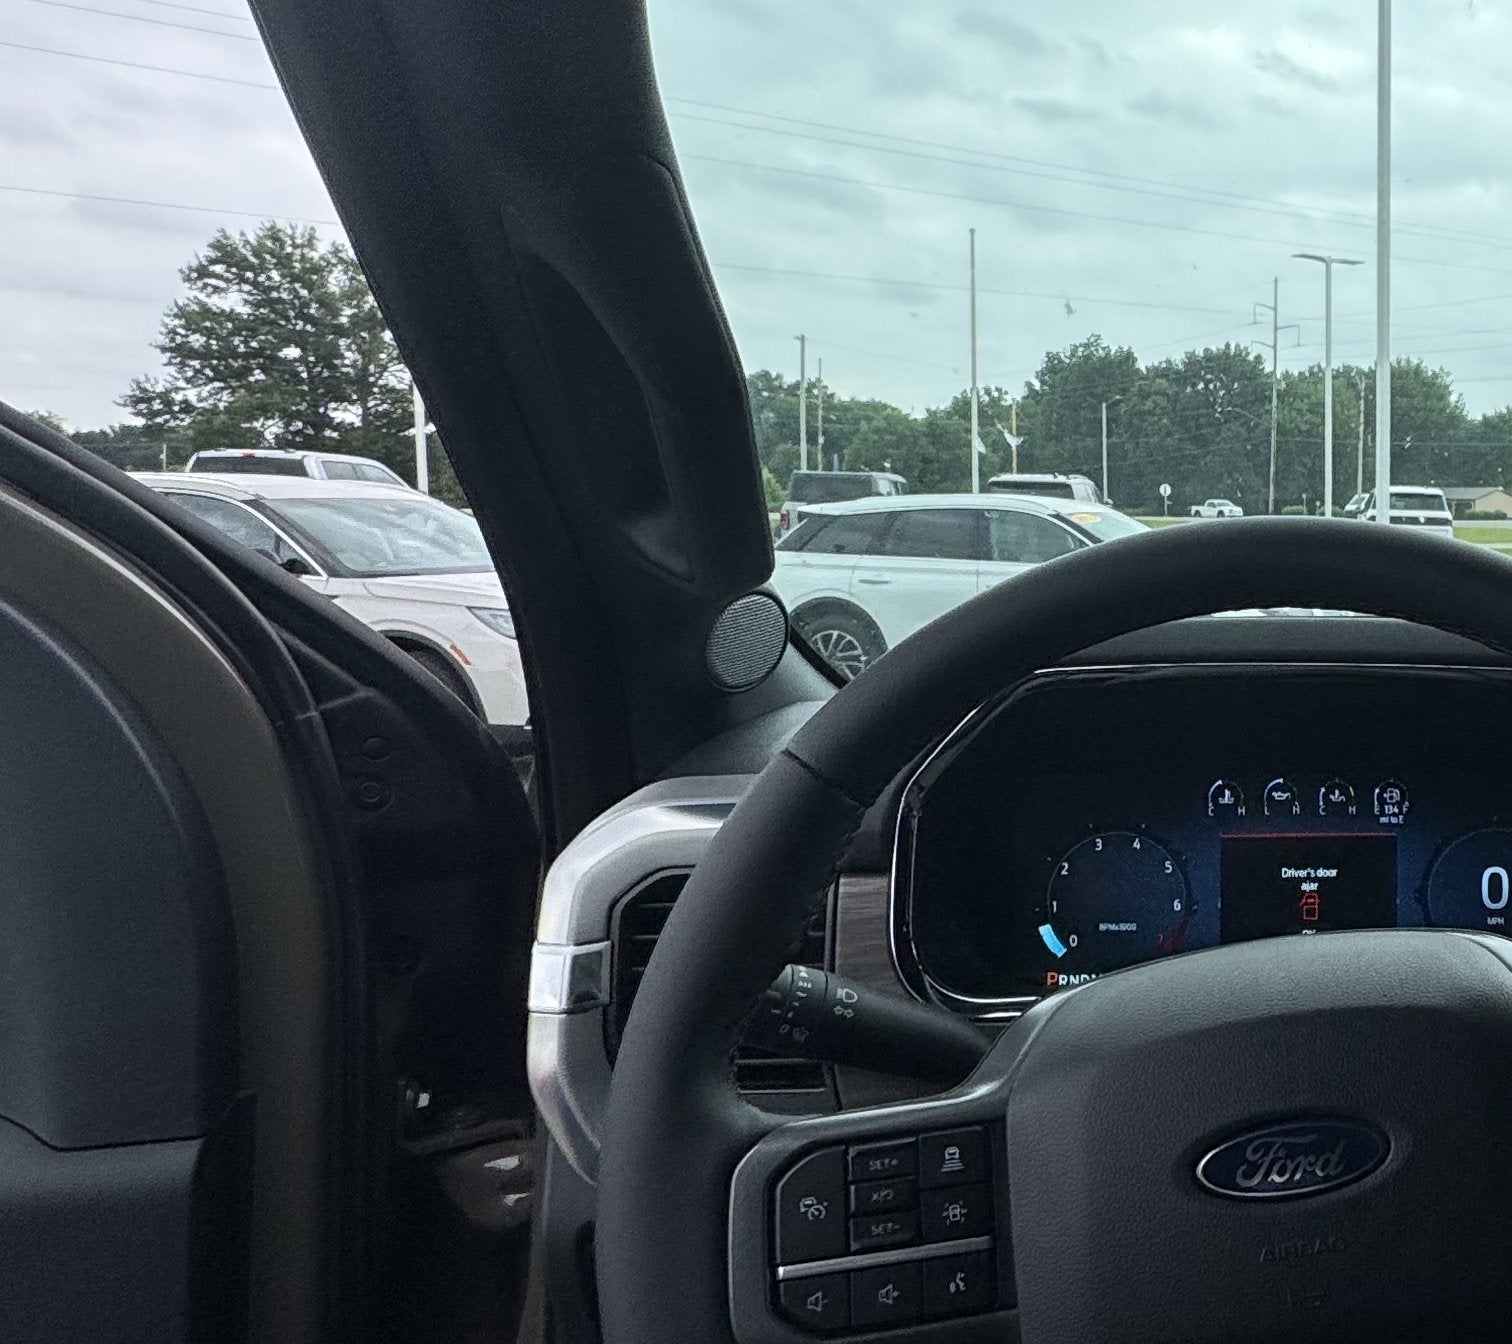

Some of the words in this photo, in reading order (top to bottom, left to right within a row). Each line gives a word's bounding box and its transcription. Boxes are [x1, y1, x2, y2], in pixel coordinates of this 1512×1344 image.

[1095, 838, 1103, 851] 3
[1132, 838, 1141, 850] 4
[1061, 862, 1069, 875] 2
[1164, 861, 1173, 873] 5
[1281, 867, 1315, 878] Driver's
[1316, 867, 1338, 877] door
[1301, 880, 1318, 892] ajar
[1481, 865, 1510, 909] 0
[1052, 900, 1057, 913] 1
[1173, 899, 1182, 911] 6
[1487, 916, 1505, 925] MPH
[1069, 935, 1078, 947] 0
[1236, 1134, 1347, 1188] Ford
